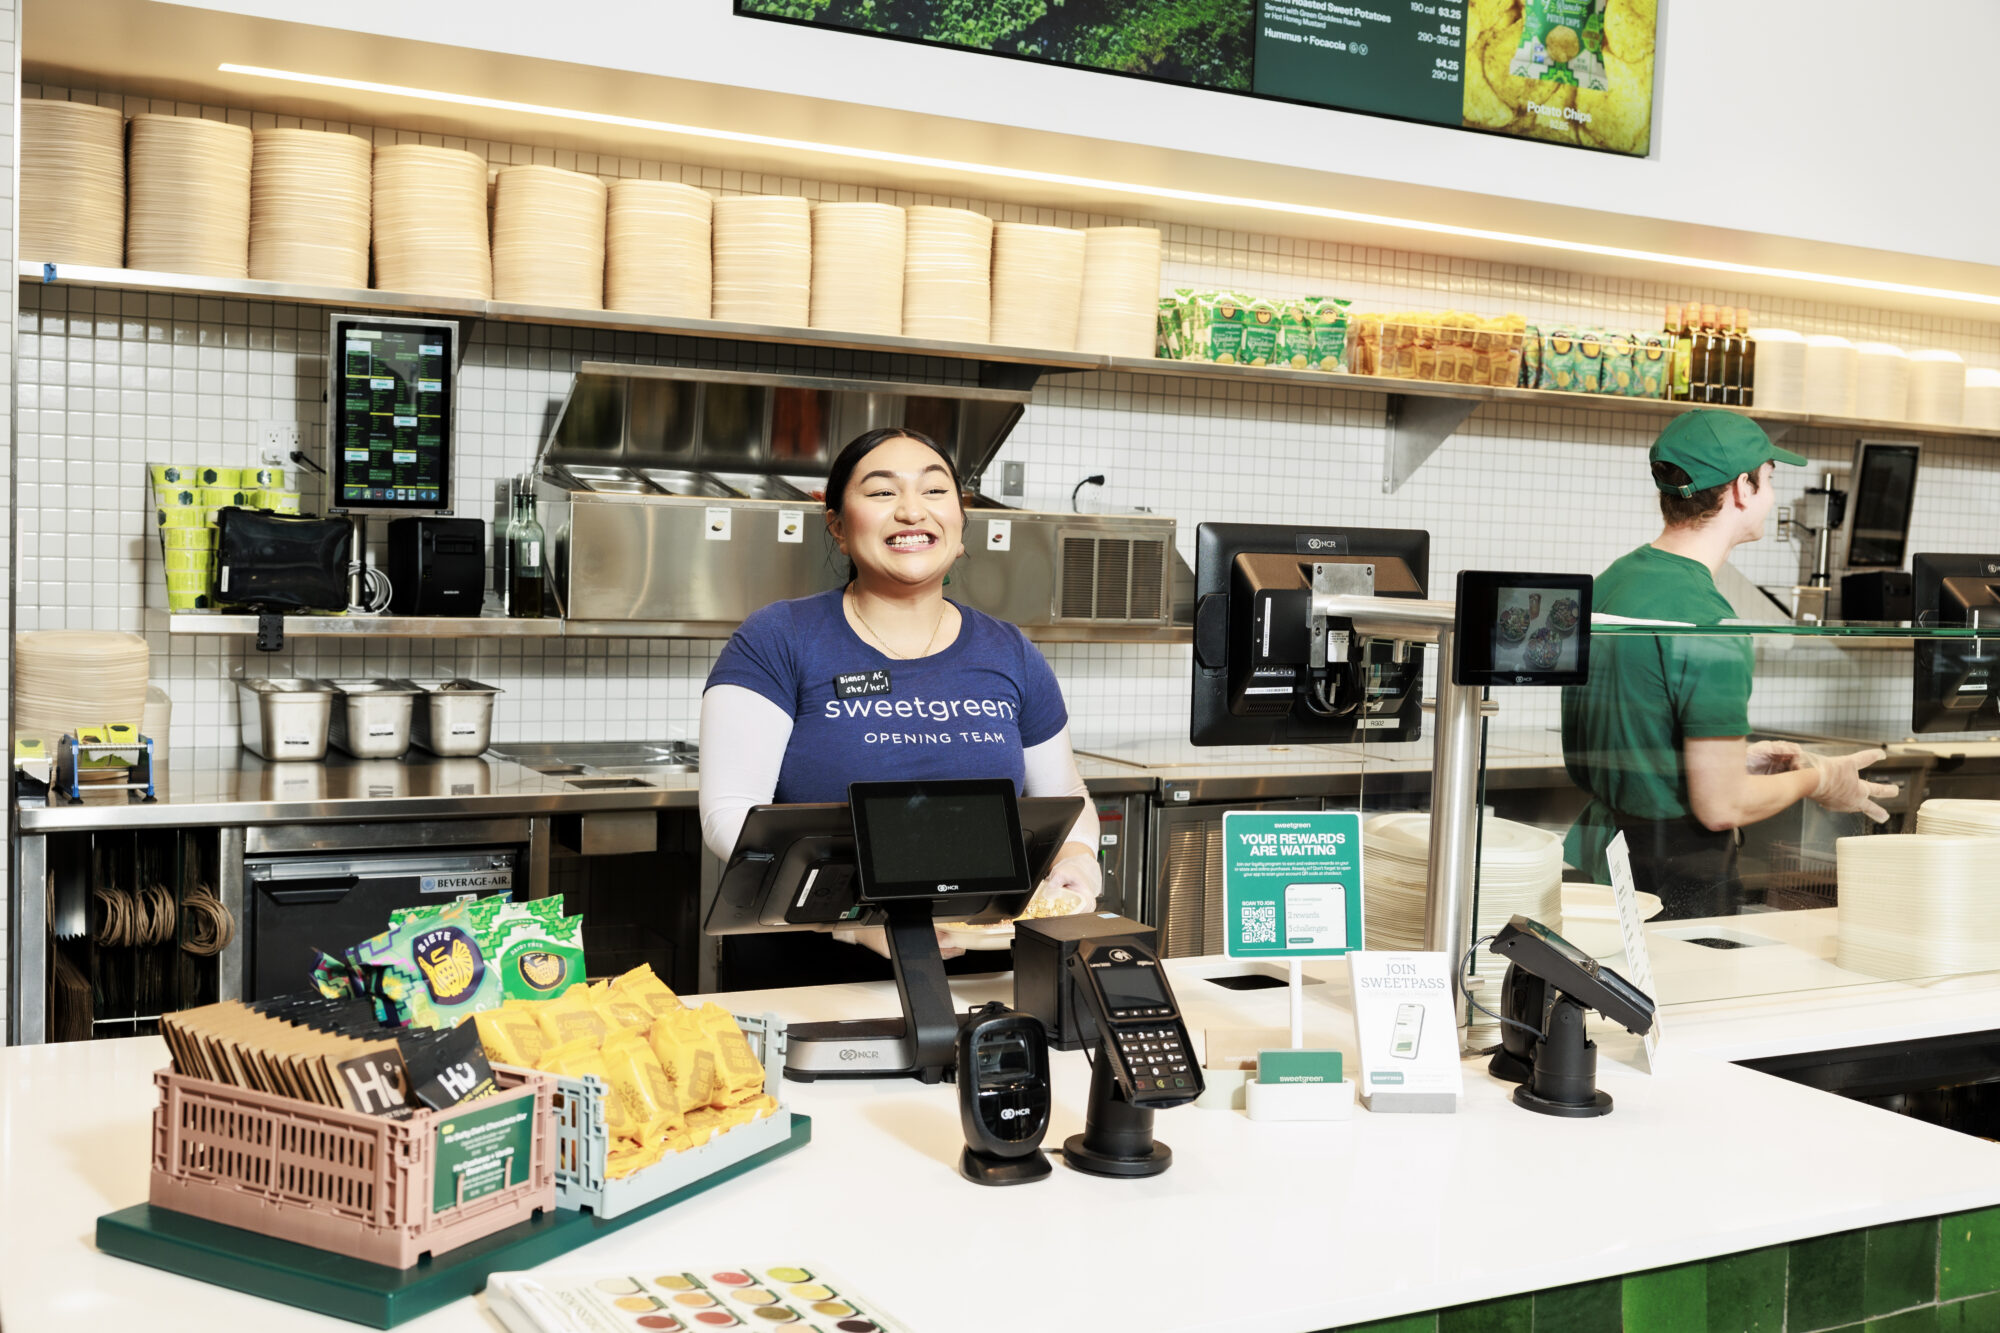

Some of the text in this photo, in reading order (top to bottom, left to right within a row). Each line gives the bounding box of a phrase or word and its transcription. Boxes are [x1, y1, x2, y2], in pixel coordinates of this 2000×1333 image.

[1265, 3, 1361, 27] Served with Green Goddess Ranch
[1328, 4, 1353, 15] Sweet
[1354, 8, 1391, 23] Potatoes
[1425, 6, 1435, 14] cal
[1438, 7, 1461, 19] $3.25
[1283, 15, 1302, 26] Honey
[1303, 18, 1326, 29] Mustard
[1440, 24, 1460, 36] $4.15
[1264, 27, 1302, 42] Hummus
[1310, 35, 1346, 50] Focaccia
[1449, 39, 1460, 48] cal
[1436, 58, 1459, 70] $4.25
[1432, 69, 1458, 82] 290 cal
[1527, 100, 1592, 124] Potato Chips
[840, 674, 865, 684] Bianca
[825, 697, 1014, 722] sweetgreen
[864, 732, 1005, 744] OPENING TEAM
[1240, 833, 1345, 844] YOUR REWARDS
[1250, 845, 1336, 856] ARE WAITING
[417, 931, 452, 954] SIETE
[1387, 963, 1416, 976] JOIN
[1361, 977, 1445, 988] SWEETPASS
[857, 1050, 879, 1059] NCR
[1015, 1108, 1030, 1116] NCR
